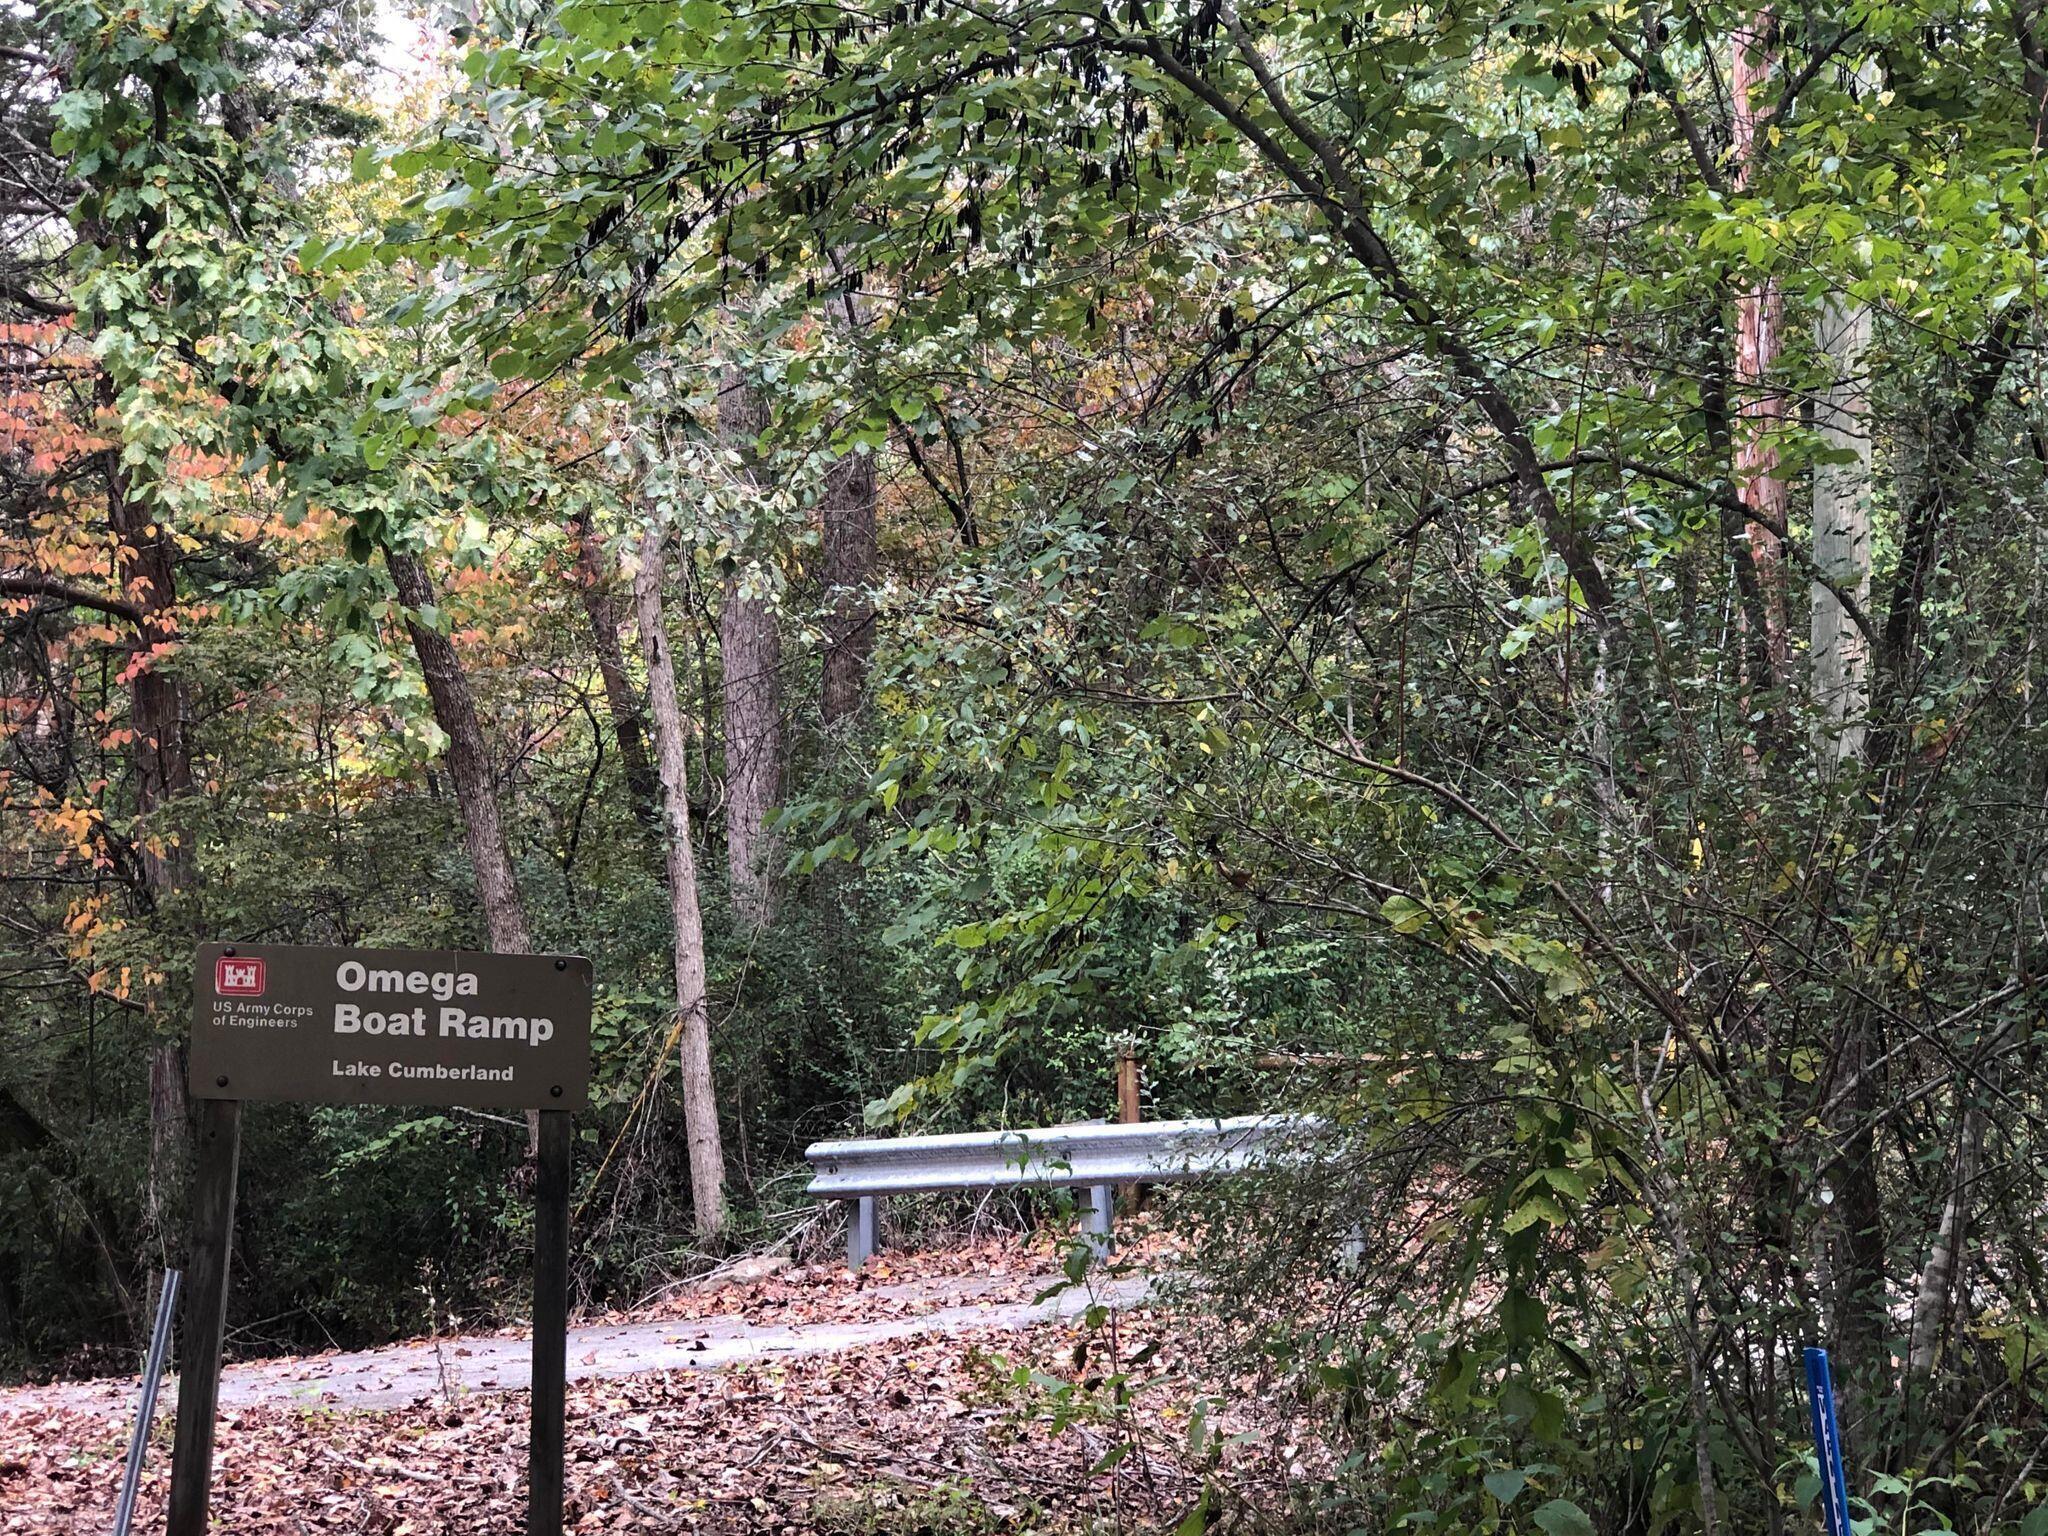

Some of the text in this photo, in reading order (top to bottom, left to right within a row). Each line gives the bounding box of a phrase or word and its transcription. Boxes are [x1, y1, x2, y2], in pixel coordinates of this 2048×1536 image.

[337, 961, 478, 1002] Omega
[212, 1001, 314, 1018] US Army Corps
[212, 1014, 298, 1029] of Engineers
[334, 1003, 554, 1047] Boat Ramp
[332, 1060, 514, 1081] Lake Cumberland
